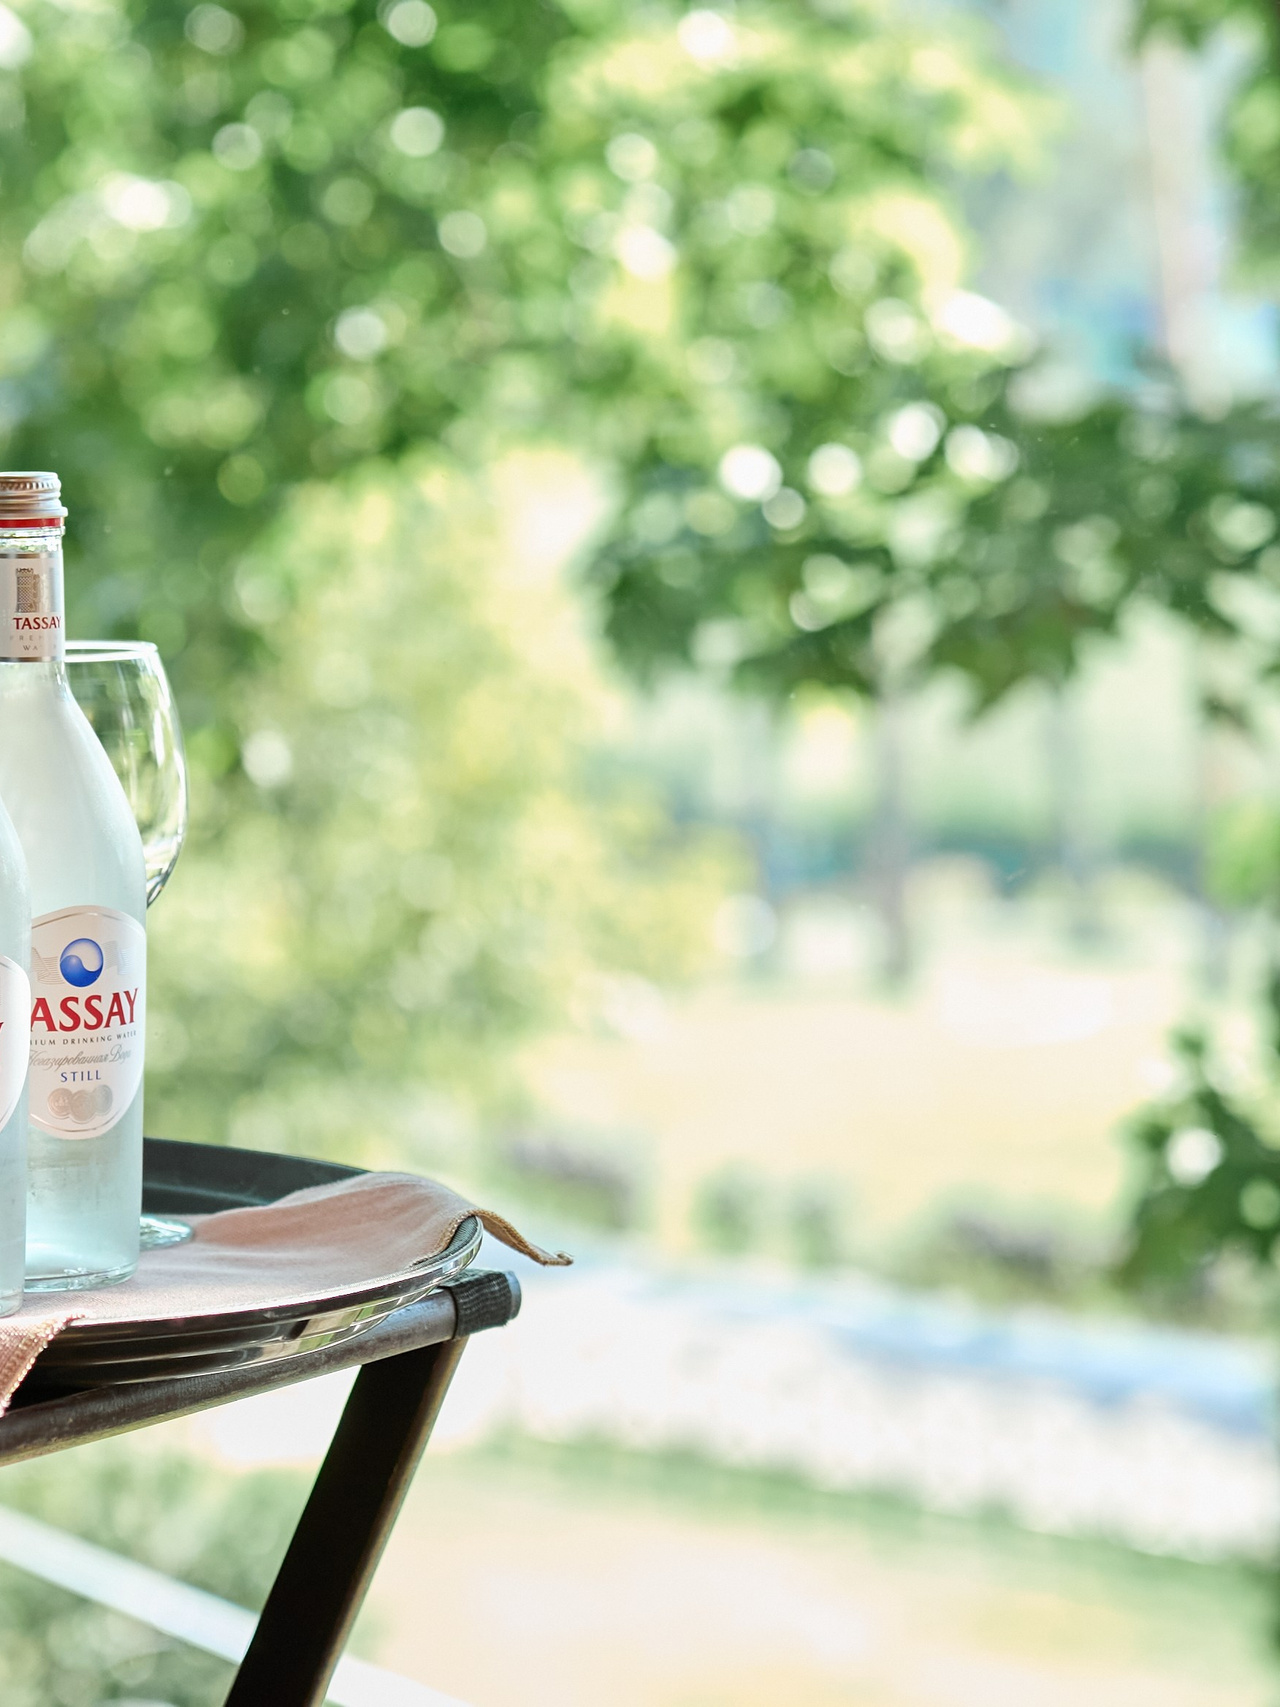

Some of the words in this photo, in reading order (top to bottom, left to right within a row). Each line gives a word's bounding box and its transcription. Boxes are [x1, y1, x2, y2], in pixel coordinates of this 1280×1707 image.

[13, 616, 61, 630] TASSAY
[30, 988, 139, 1032] ASSAY
[63, 1035, 112, 1046] DRINKING
[116, 1030, 137, 1040] WATER
[60, 1070, 101, 1083] STILL
